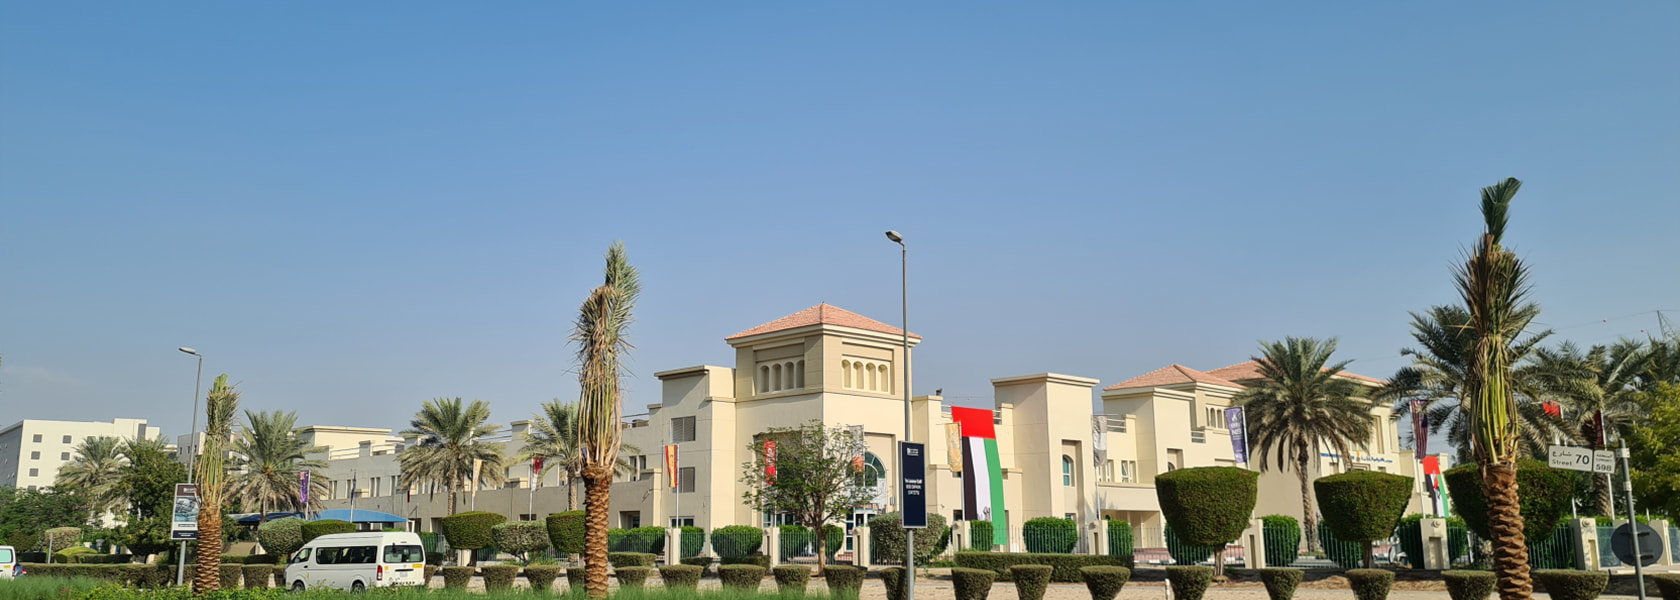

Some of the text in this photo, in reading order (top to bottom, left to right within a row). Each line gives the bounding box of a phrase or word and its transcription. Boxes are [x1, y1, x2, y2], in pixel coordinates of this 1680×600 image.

[1552, 450, 1572, 458] شارع
[1575, 454, 1590, 465] 70
[1595, 464, 1612, 472] 598
